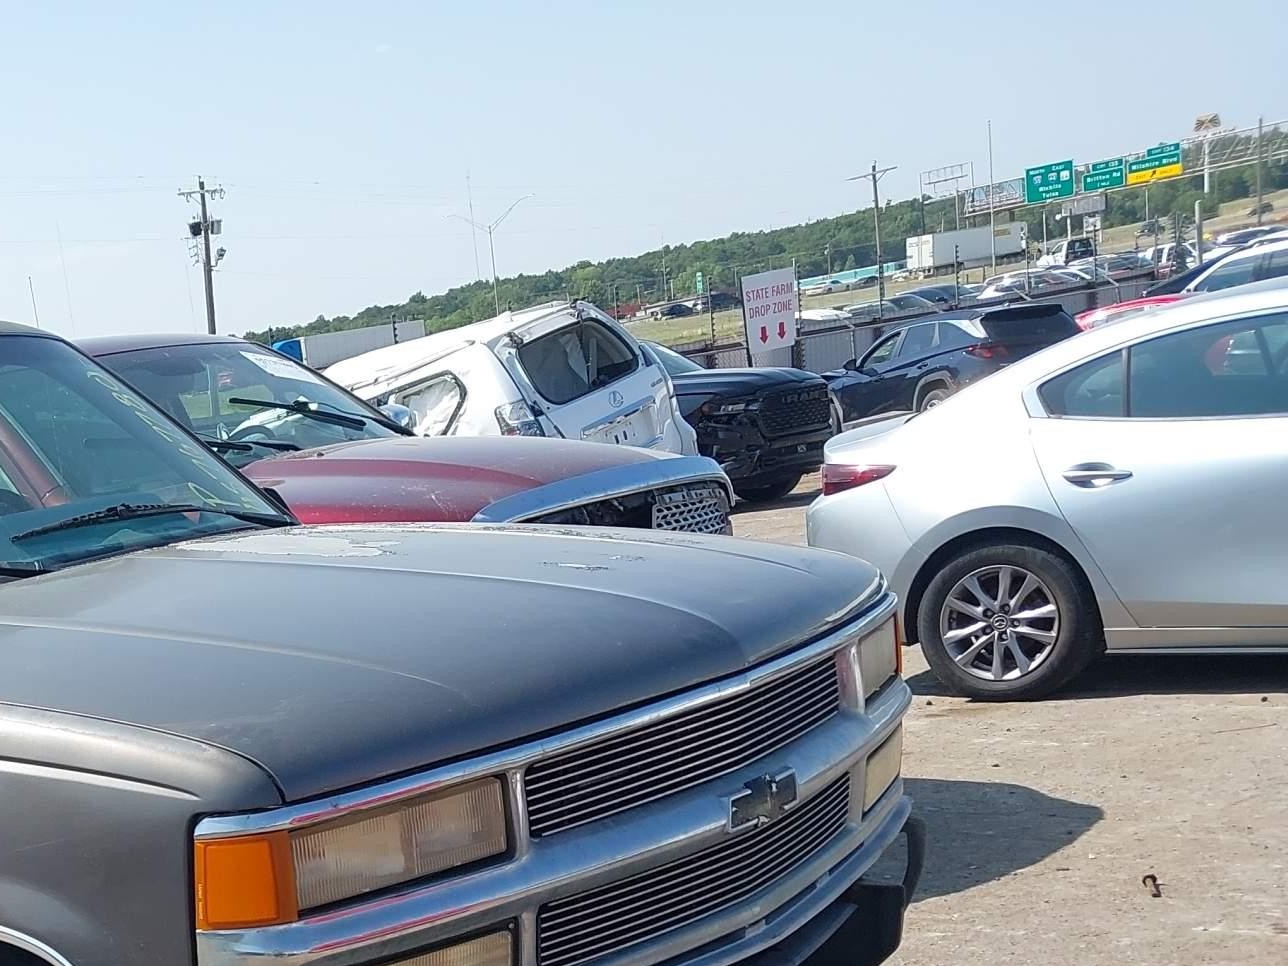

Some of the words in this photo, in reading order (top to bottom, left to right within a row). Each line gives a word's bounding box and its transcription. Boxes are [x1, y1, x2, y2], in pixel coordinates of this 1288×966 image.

[1131, 161, 1160, 170] Wilshire
[1086, 174, 1110, 183] Britton
[1038, 183, 1062, 192] Wichita
[745, 287, 769, 302] STATE
[772, 282, 793, 297] FARM
[749, 304, 771, 320] DROP
[773, 300, 793, 314] ZONE
